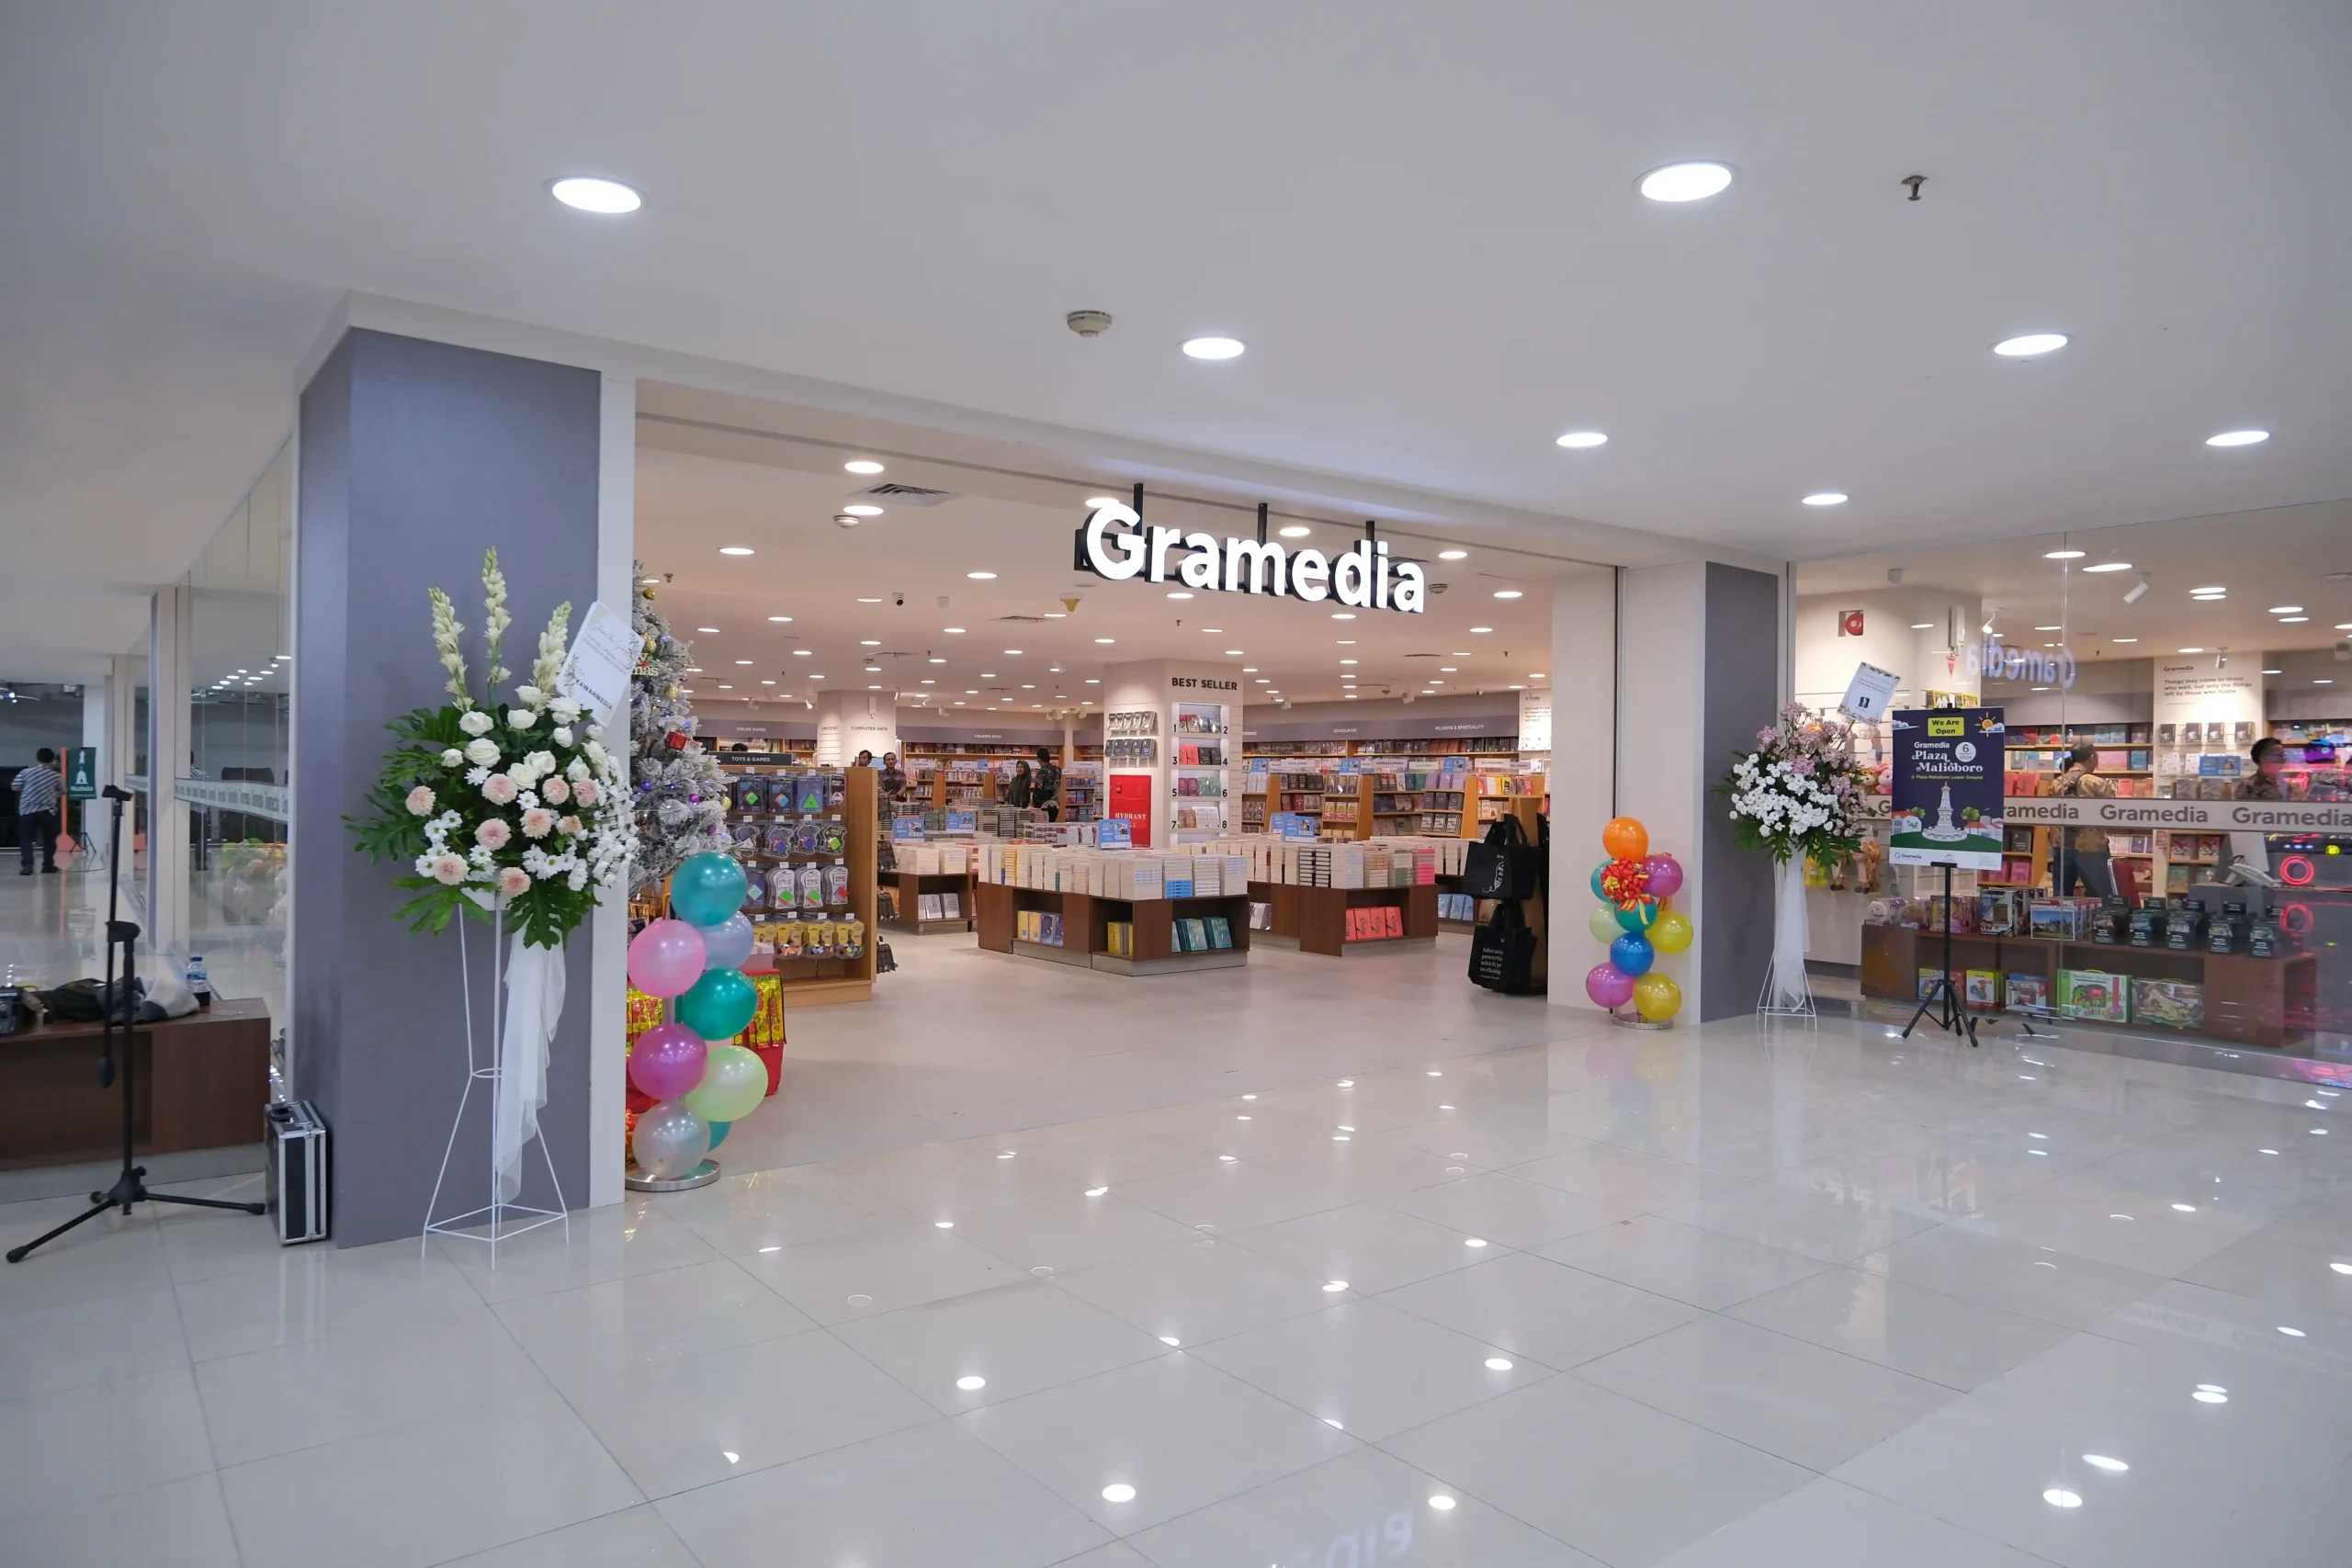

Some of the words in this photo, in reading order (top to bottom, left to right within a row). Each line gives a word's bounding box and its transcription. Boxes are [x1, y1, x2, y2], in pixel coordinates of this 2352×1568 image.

[1084, 502, 1425, 614] Gramedia
[632, 666, 659, 676] mas
[1172, 677, 1197, 688] BEST
[1201, 679, 1238, 690] SELLER
[1173, 757, 1177, 765] 3
[1912, 750, 1950, 762] Plaza
[1222, 757, 1228, 766] 4
[1916, 762, 1983, 772] Malioboro
[1172, 789, 1177, 797] 5
[1222, 789, 1228, 797] 6
[2100, 804, 2208, 823] Gramedia
[2232, 807, 2352, 827] Gramedia
[1171, 821, 1177, 829] 7
